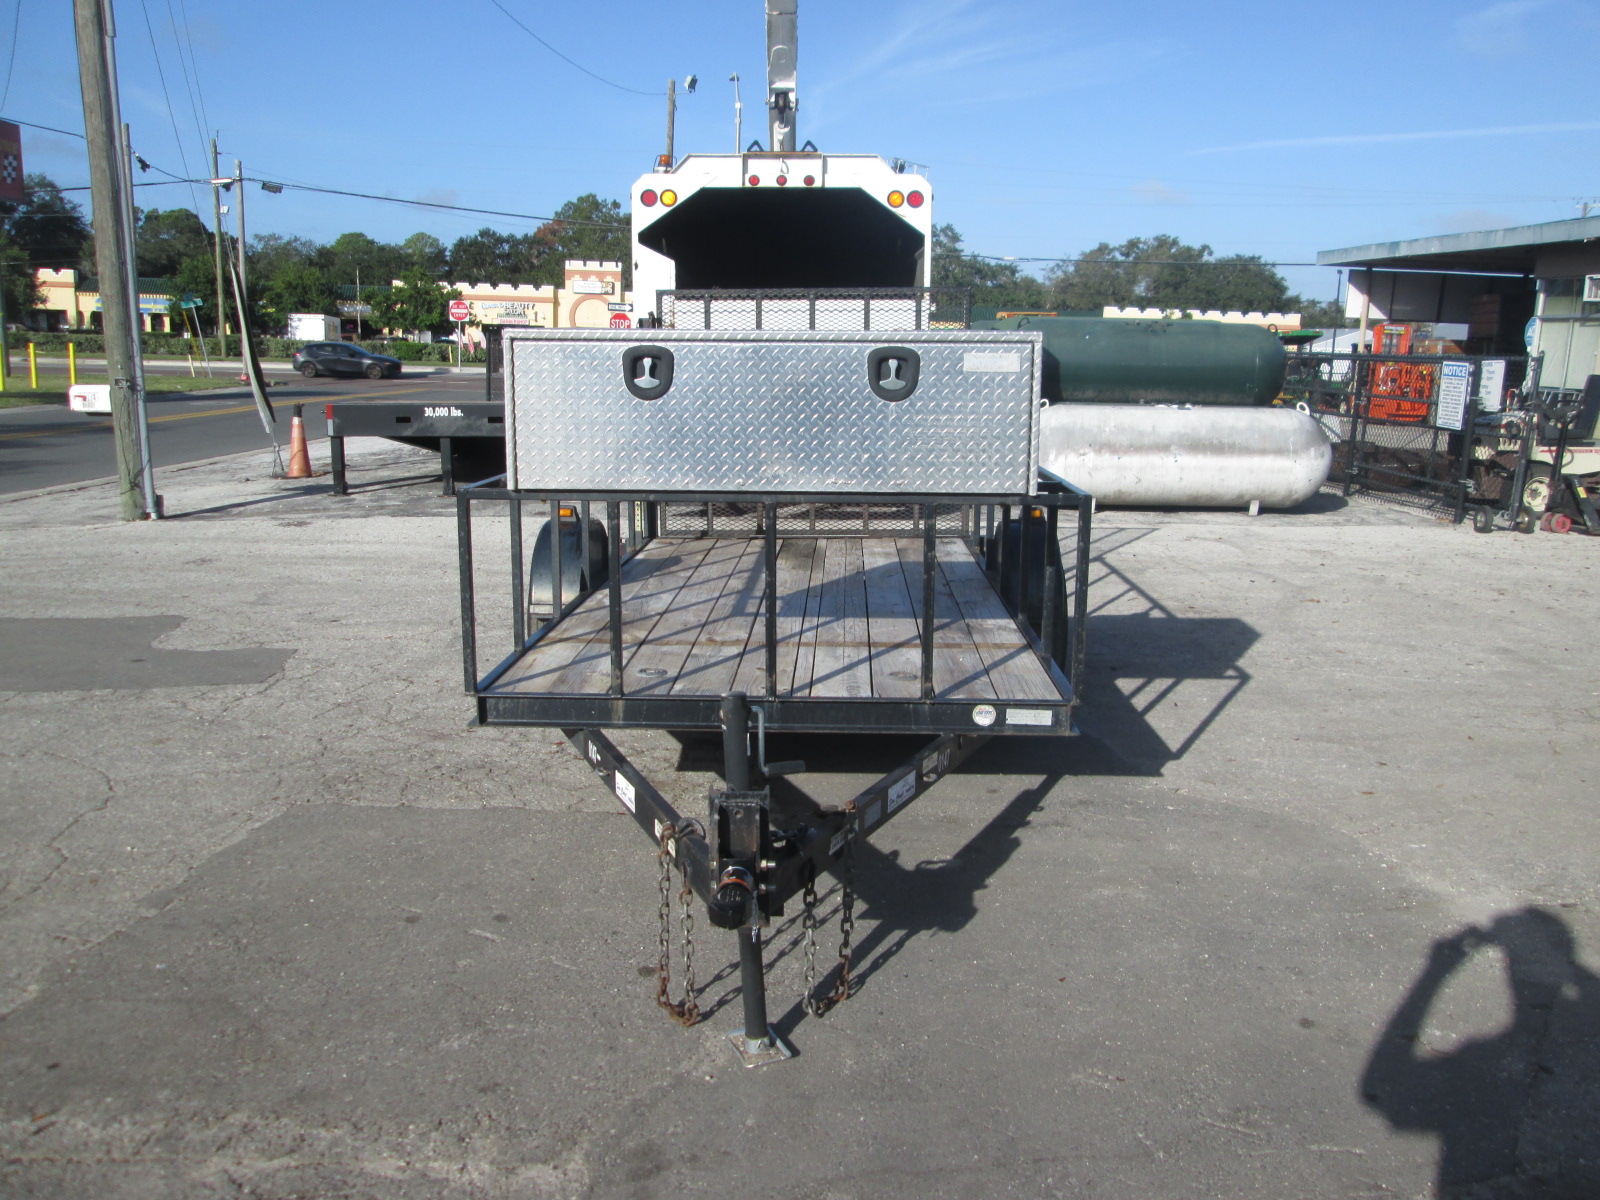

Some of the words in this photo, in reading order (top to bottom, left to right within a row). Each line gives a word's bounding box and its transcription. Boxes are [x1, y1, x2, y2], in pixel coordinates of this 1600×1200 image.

[610, 319, 631, 329] STOP
[1443, 365, 1467, 376] NOTICE
[424, 407, 449, 418] 30,000
[450, 407, 464, 417] lbs.
